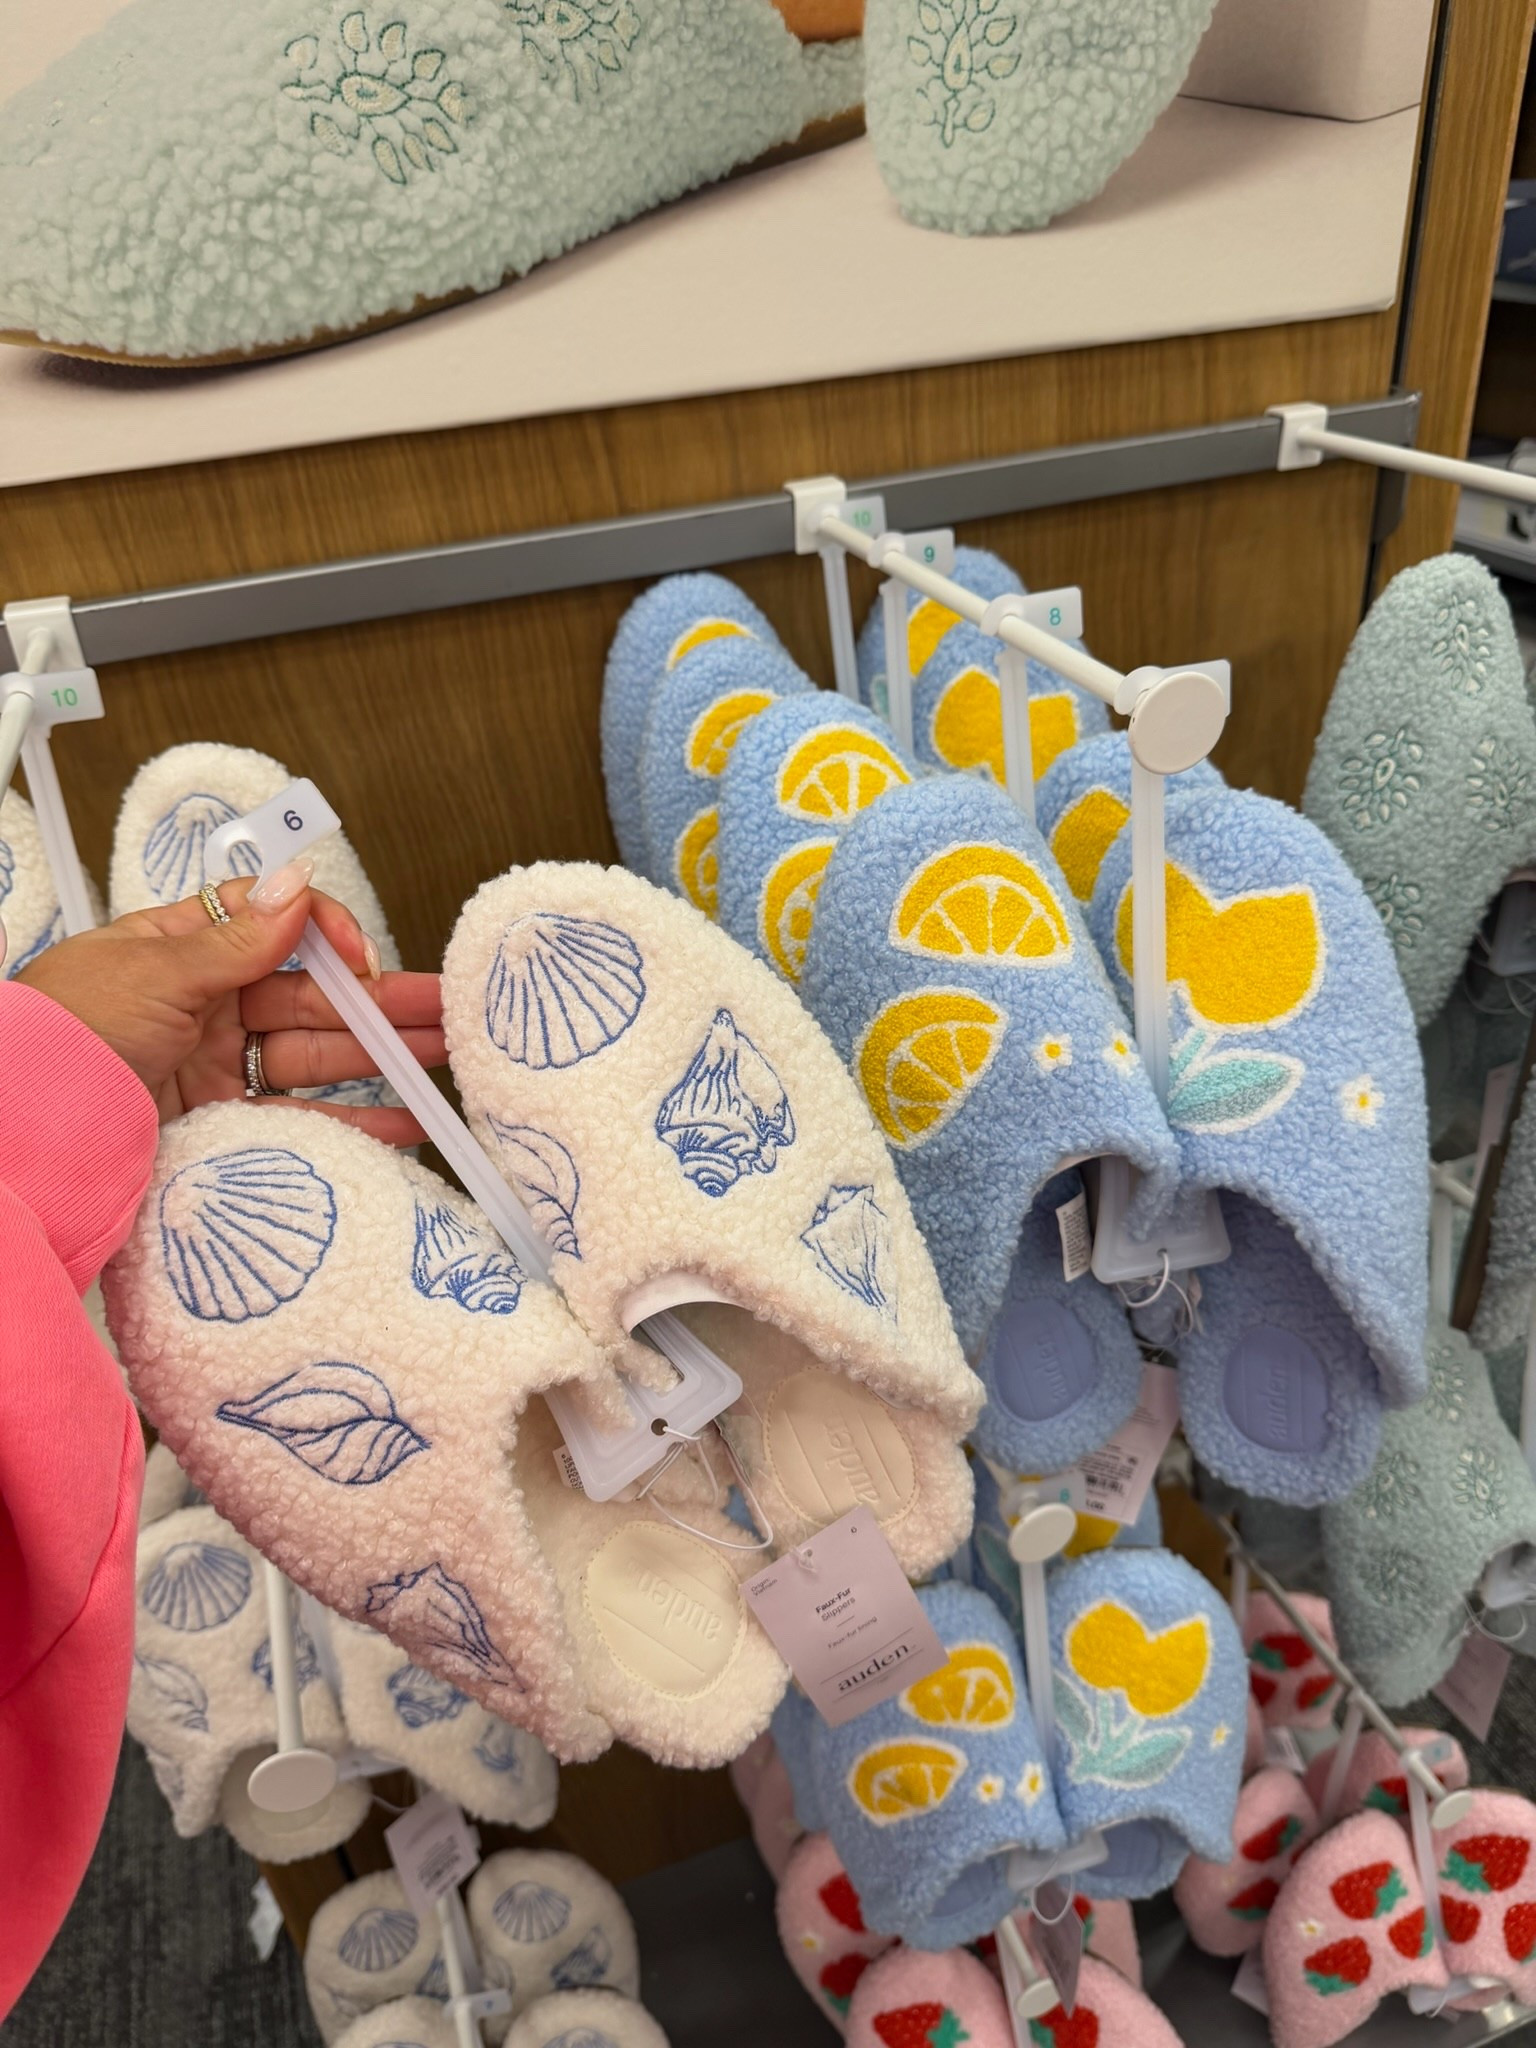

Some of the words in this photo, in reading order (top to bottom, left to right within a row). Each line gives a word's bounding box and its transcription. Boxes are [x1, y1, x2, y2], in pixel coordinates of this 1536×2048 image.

[853, 510, 871, 527] 10
[924, 545, 935, 563] 9
[1049, 606, 1062, 626] 8
[51, 687, 78, 708] 10
[283, 809, 304, 832] 6
[637, 1567, 724, 1641] auden
[815, 1587, 851, 1614] Faux-Fur
[821, 1596, 856, 1622] Slippers
[838, 1644, 909, 1691] auden
